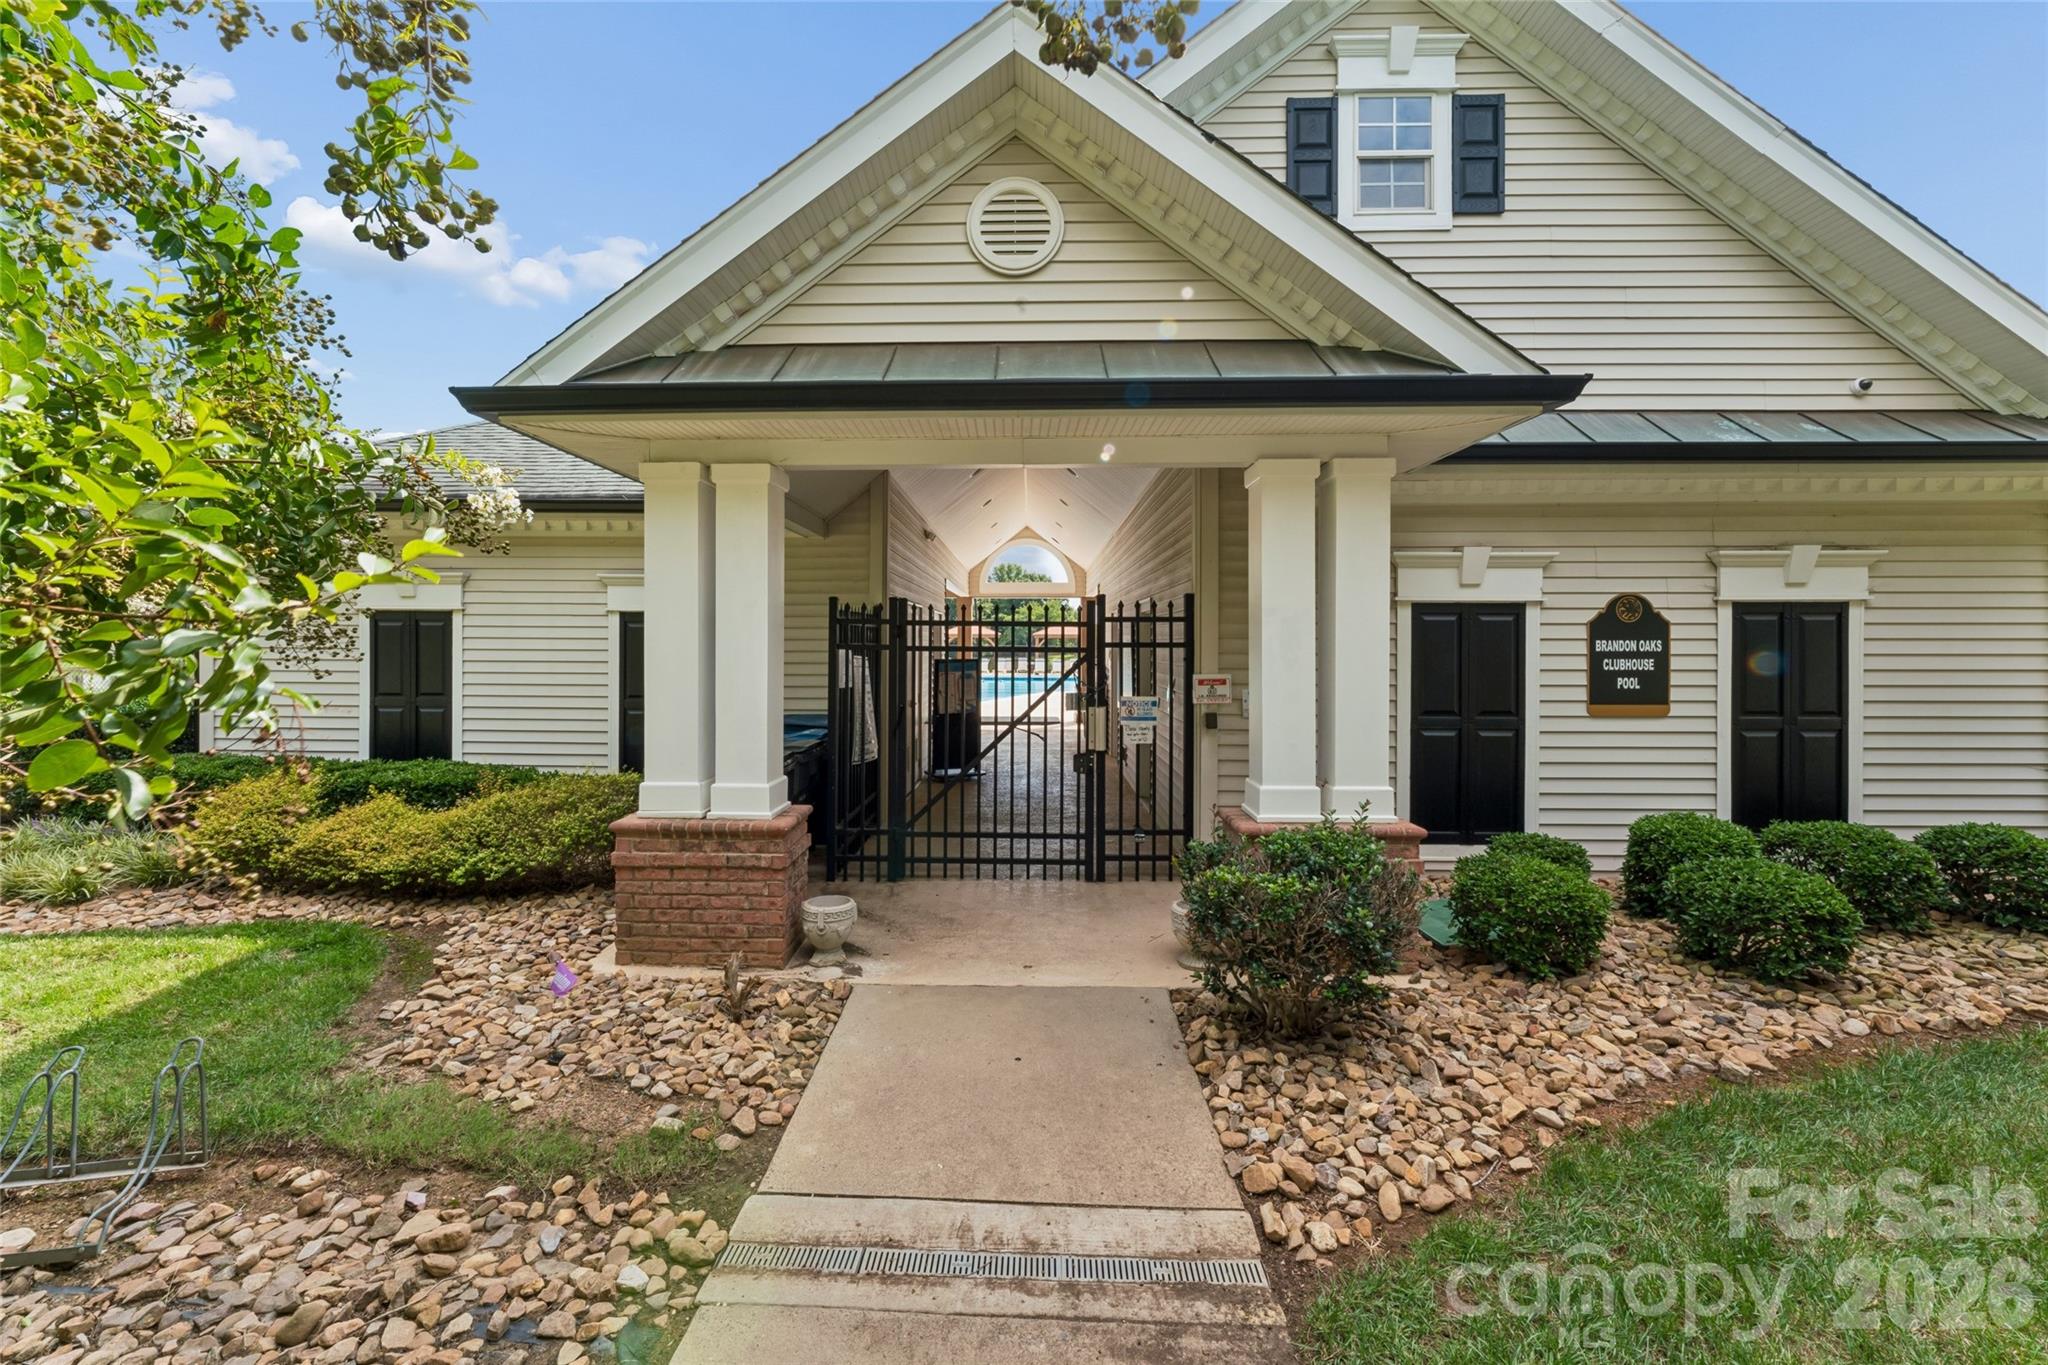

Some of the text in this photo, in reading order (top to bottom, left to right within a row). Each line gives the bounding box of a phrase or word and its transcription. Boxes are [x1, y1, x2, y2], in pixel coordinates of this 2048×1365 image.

[1595, 640, 1662, 652] BRANDON OAKS
[1603, 659, 1654, 671] CLUBHOUSE
[1617, 677, 1640, 689] POOL
